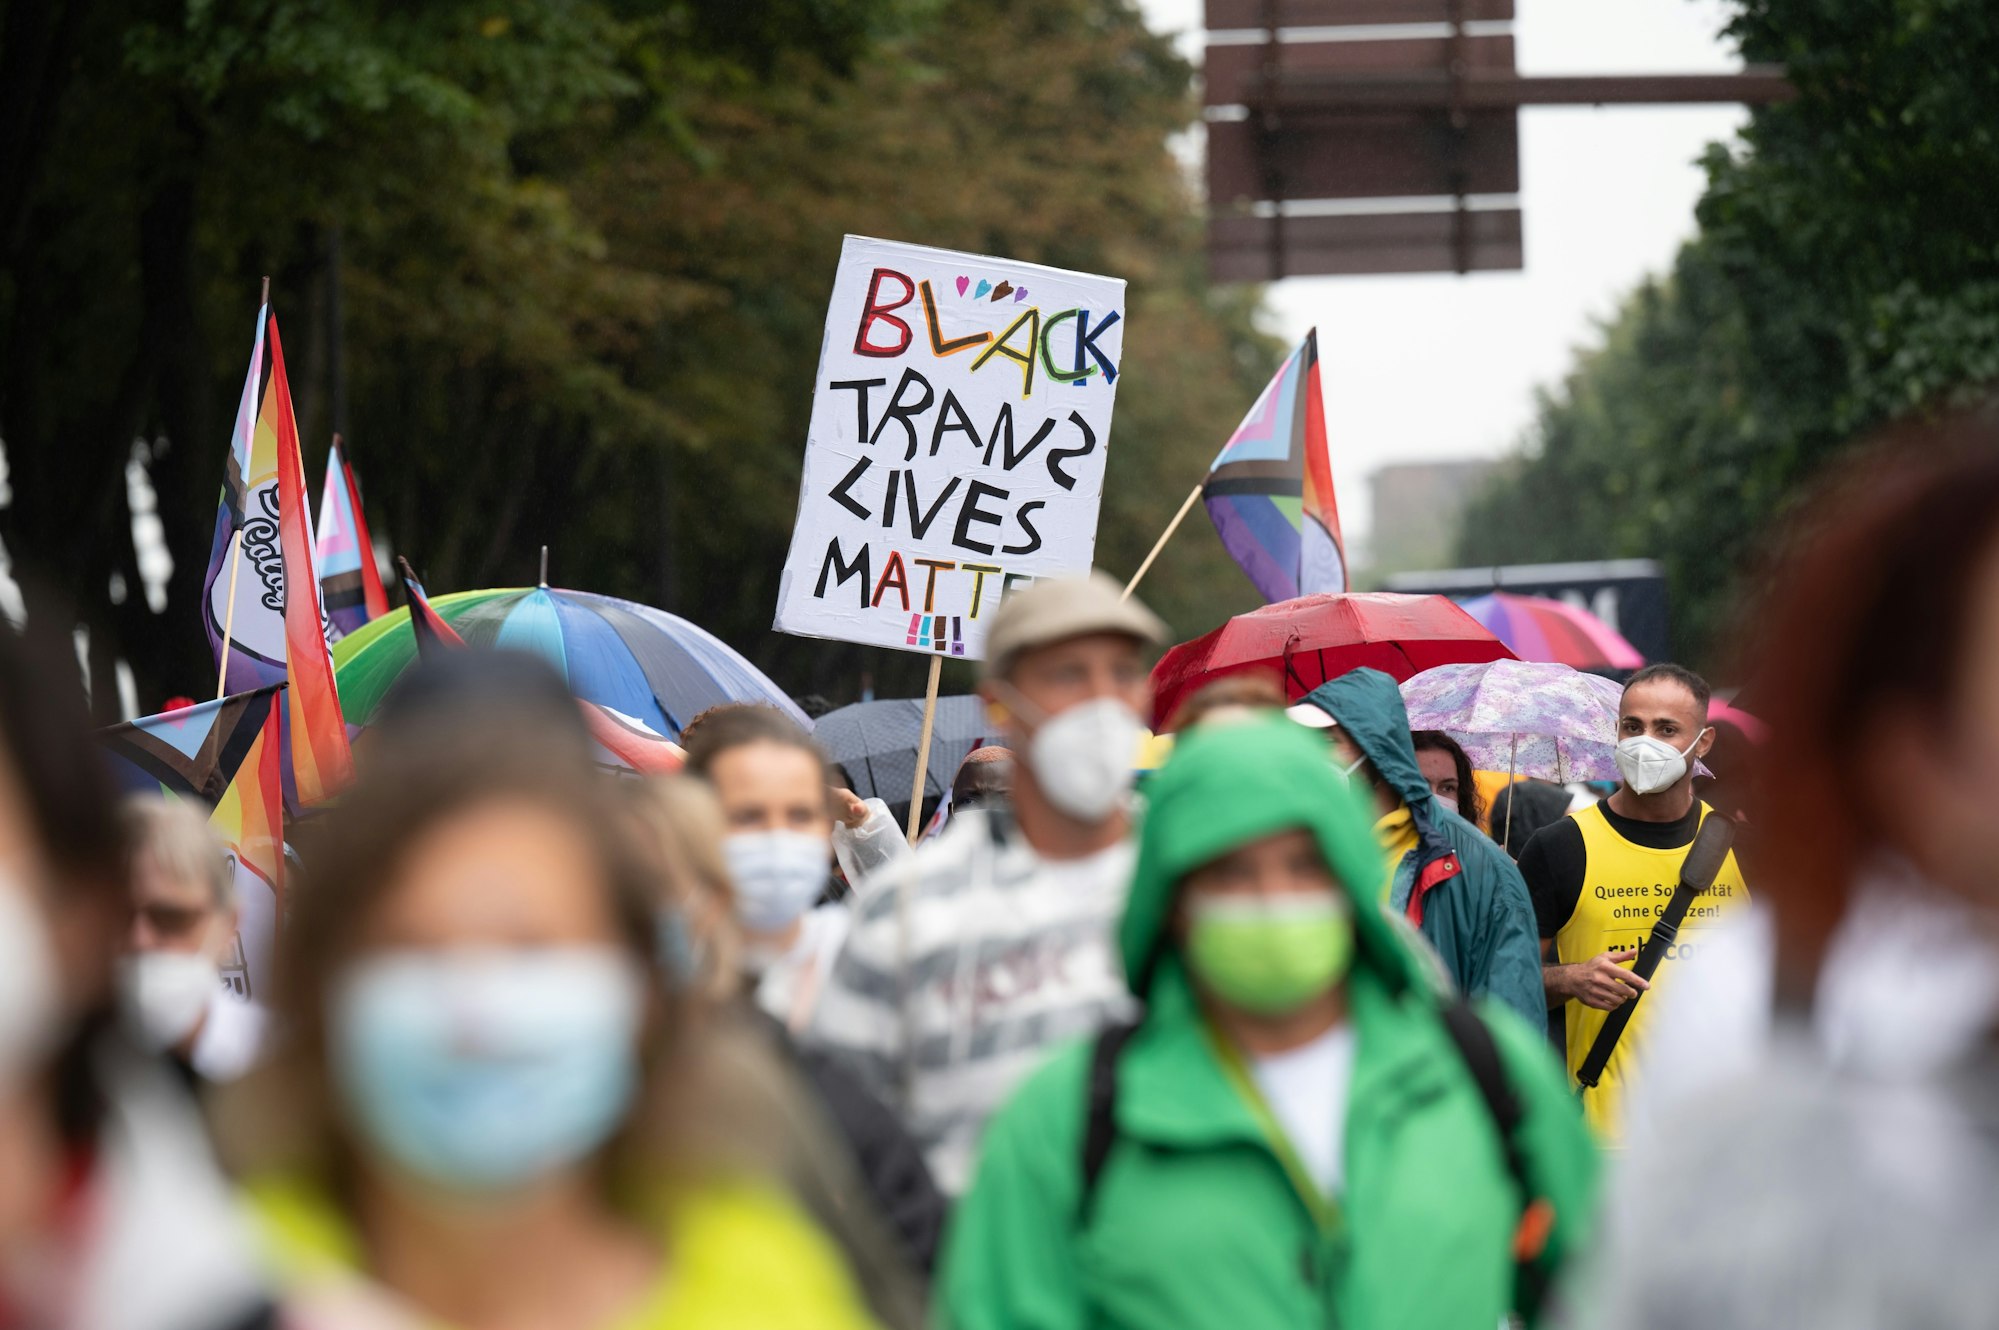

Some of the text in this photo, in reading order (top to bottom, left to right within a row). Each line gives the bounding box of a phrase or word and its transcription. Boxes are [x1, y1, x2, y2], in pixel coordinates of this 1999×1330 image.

[853, 268, 1121, 400] BLACK
[829, 366, 1096, 491] TRANS
[828, 455, 1046, 556] LIVES
[813, 536, 1048, 620] MATTE
[1595, 883, 1732, 899] Queere Solrität
[1613, 904, 1720, 919] ohne Gzen!
